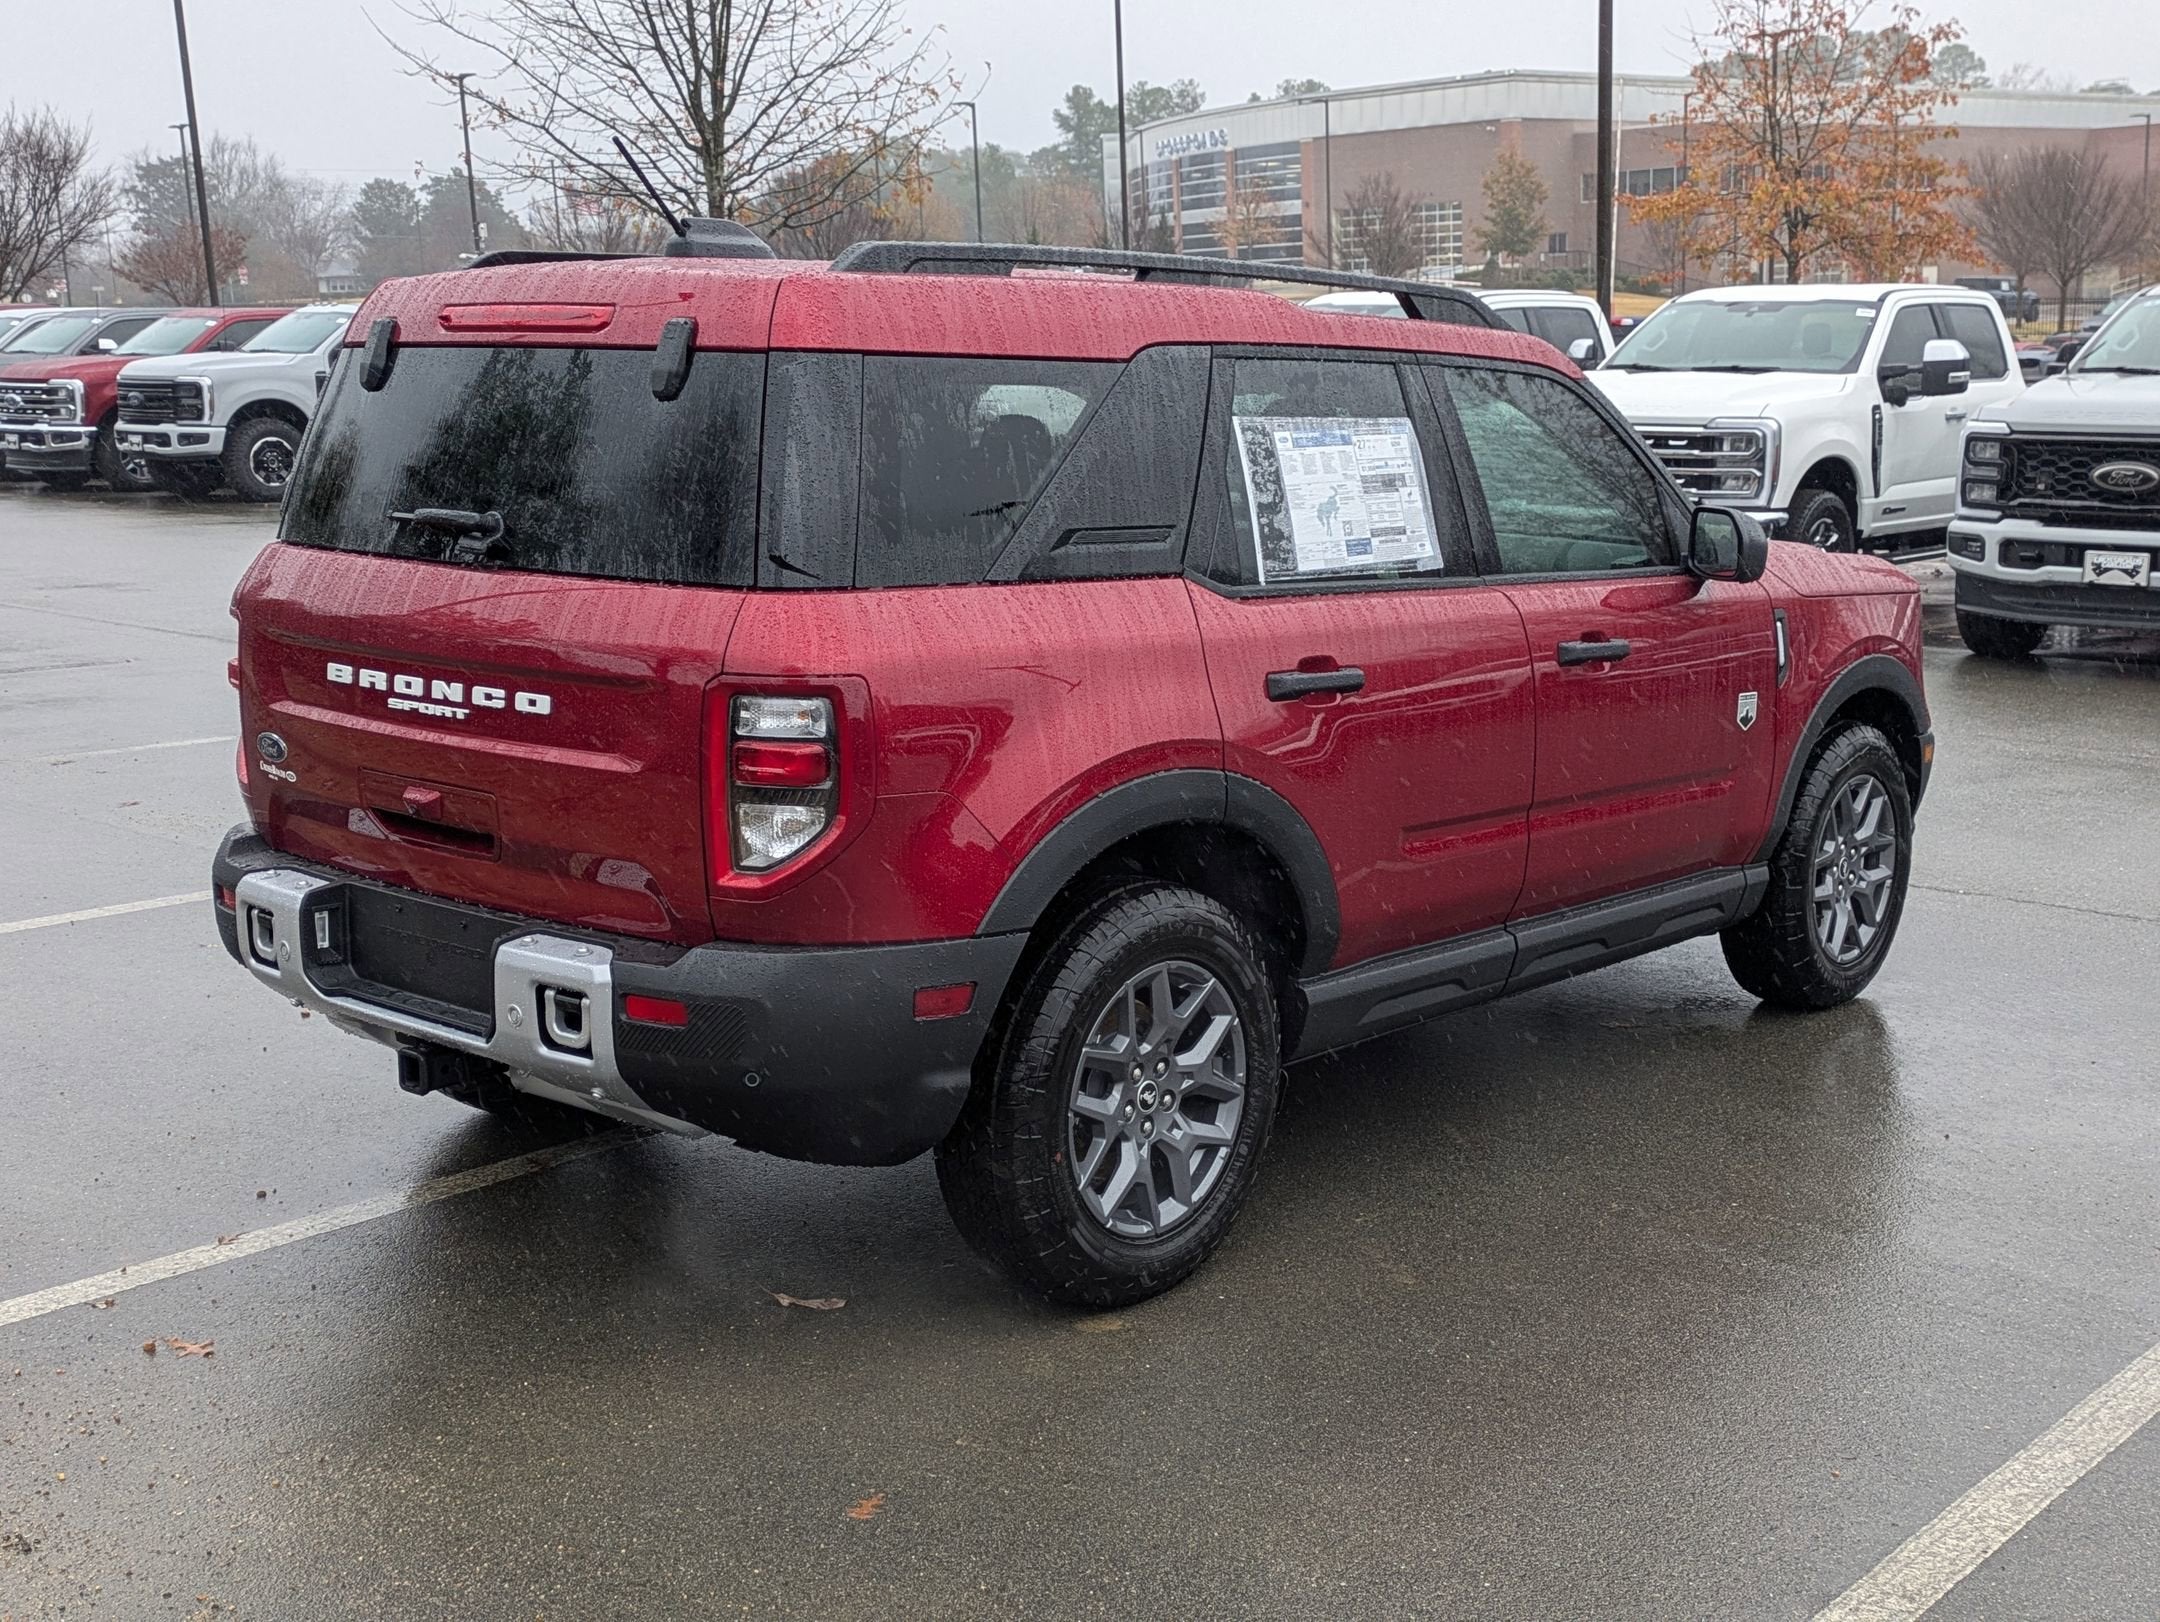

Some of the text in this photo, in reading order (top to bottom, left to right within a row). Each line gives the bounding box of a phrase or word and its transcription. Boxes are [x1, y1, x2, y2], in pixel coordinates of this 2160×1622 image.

[2107, 470, 2144, 485] Ford
[327, 662, 551, 715] BRONCO
[387, 697, 470, 720] SPORT
